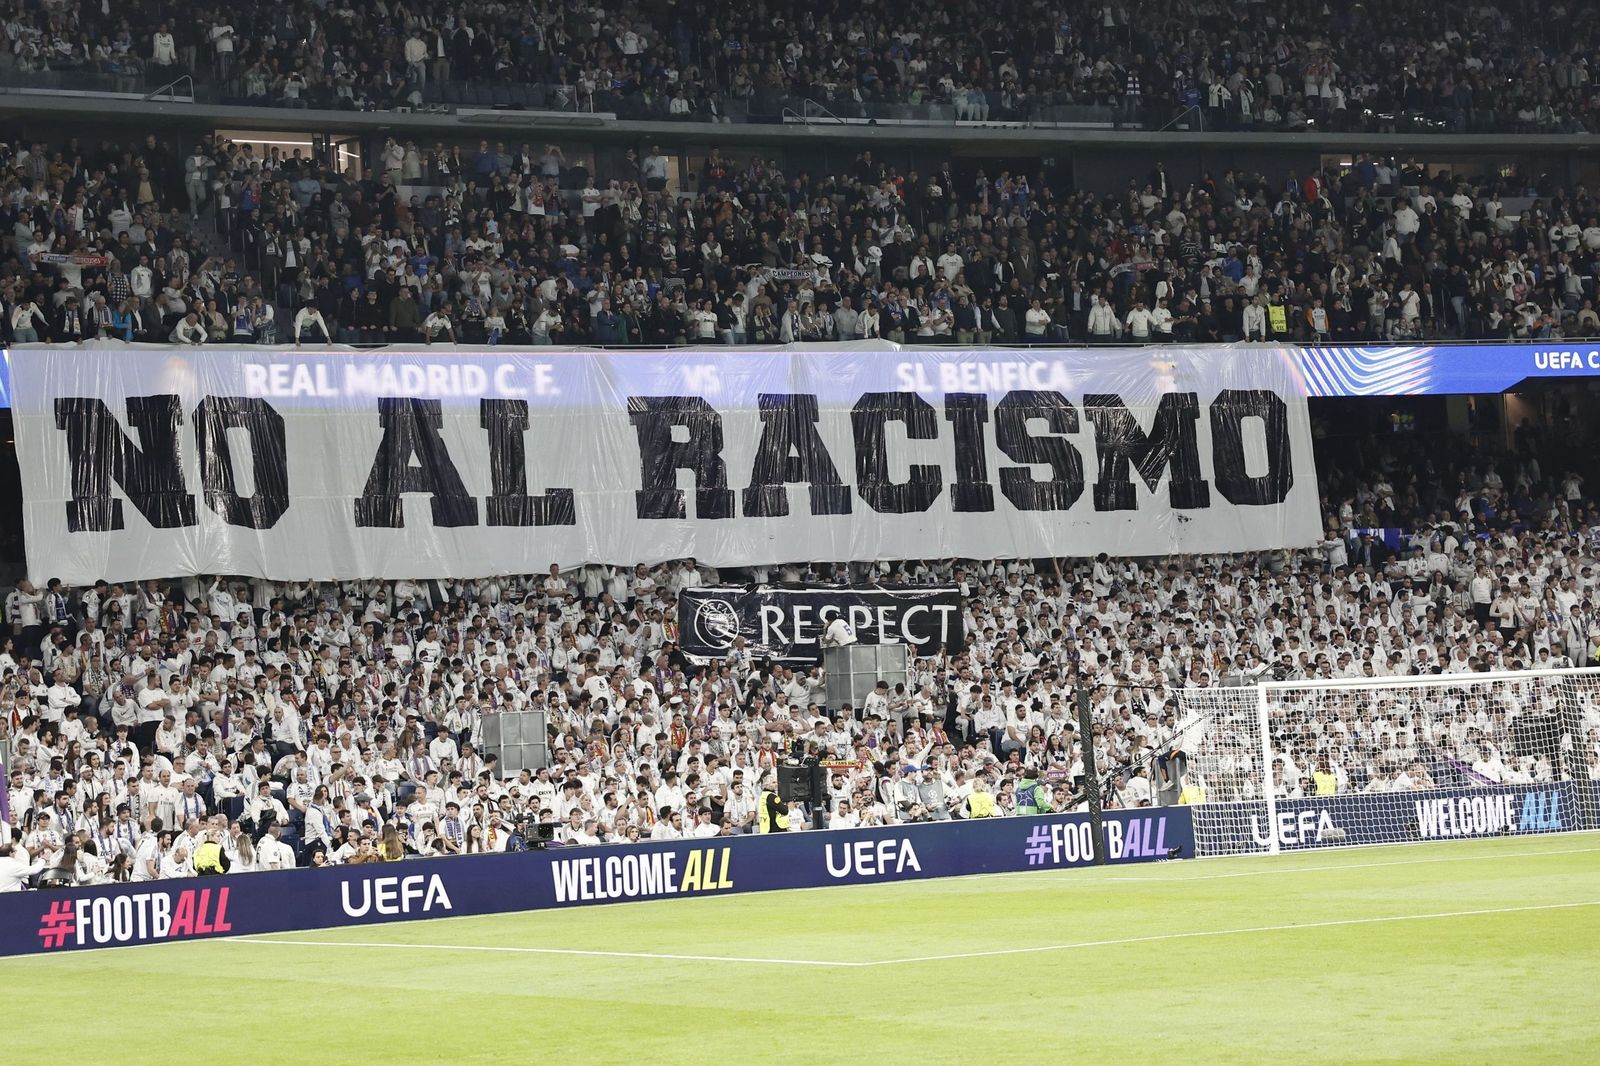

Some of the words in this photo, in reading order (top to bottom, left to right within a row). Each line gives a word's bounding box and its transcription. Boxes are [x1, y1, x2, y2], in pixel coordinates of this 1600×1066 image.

[245, 364, 338, 397] REAL
[345, 364, 487, 397] MADRID
[896, 361, 935, 393] SL
[940, 360, 1071, 392] BENFICA
[1534, 351, 1584, 369] UEFA
[54, 395, 289, 532] NO
[354, 397, 577, 527] AL
[627, 388, 1294, 519] RACISMO
[1251, 809, 1336, 846] UEFA
[1415, 794, 1517, 837] WELCOME
[1519, 791, 1562, 830] ALL
[551, 851, 678, 903] WELCOME
[680, 847, 734, 892] ALL
[825, 838, 921, 878] UEFA
[341, 873, 452, 918] UEFA
[37, 886, 232, 948] #FOOTBALL
